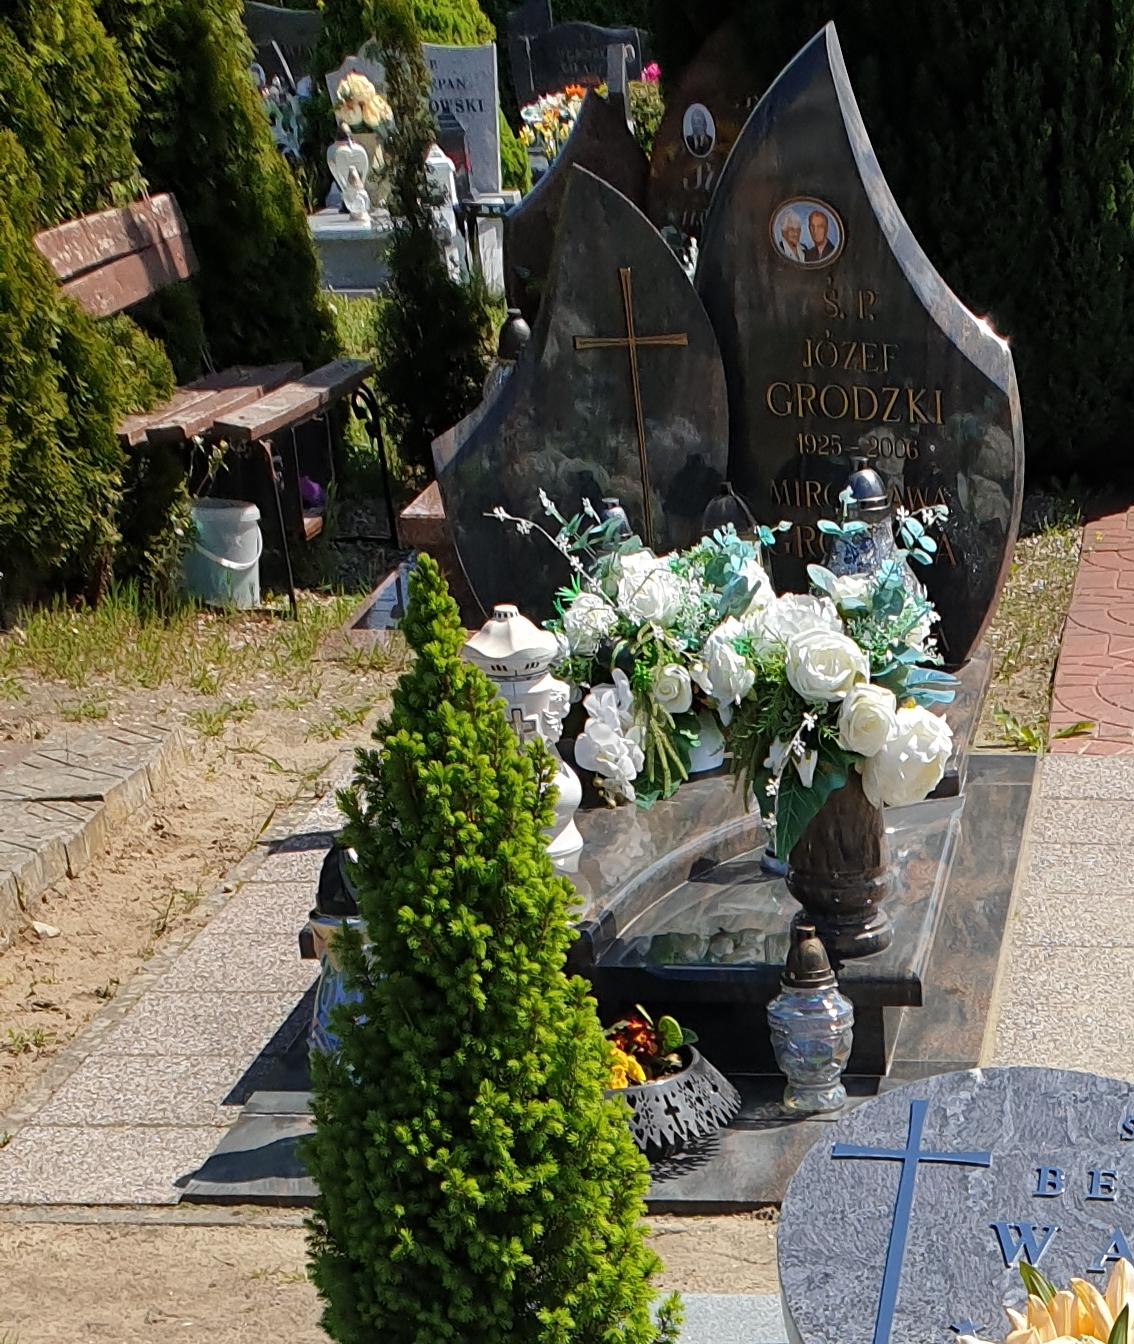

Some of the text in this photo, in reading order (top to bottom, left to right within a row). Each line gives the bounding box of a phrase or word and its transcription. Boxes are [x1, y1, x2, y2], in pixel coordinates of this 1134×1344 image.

[429, 99, 484, 113] OWSKI
[802, 330, 898, 372] JÓZEF
[766, 382, 945, 425] GRODZKI
[797, 433, 842, 456] 1925
[866, 436, 920, 460] 2006
[769, 479, 949, 508] MIRAWA
